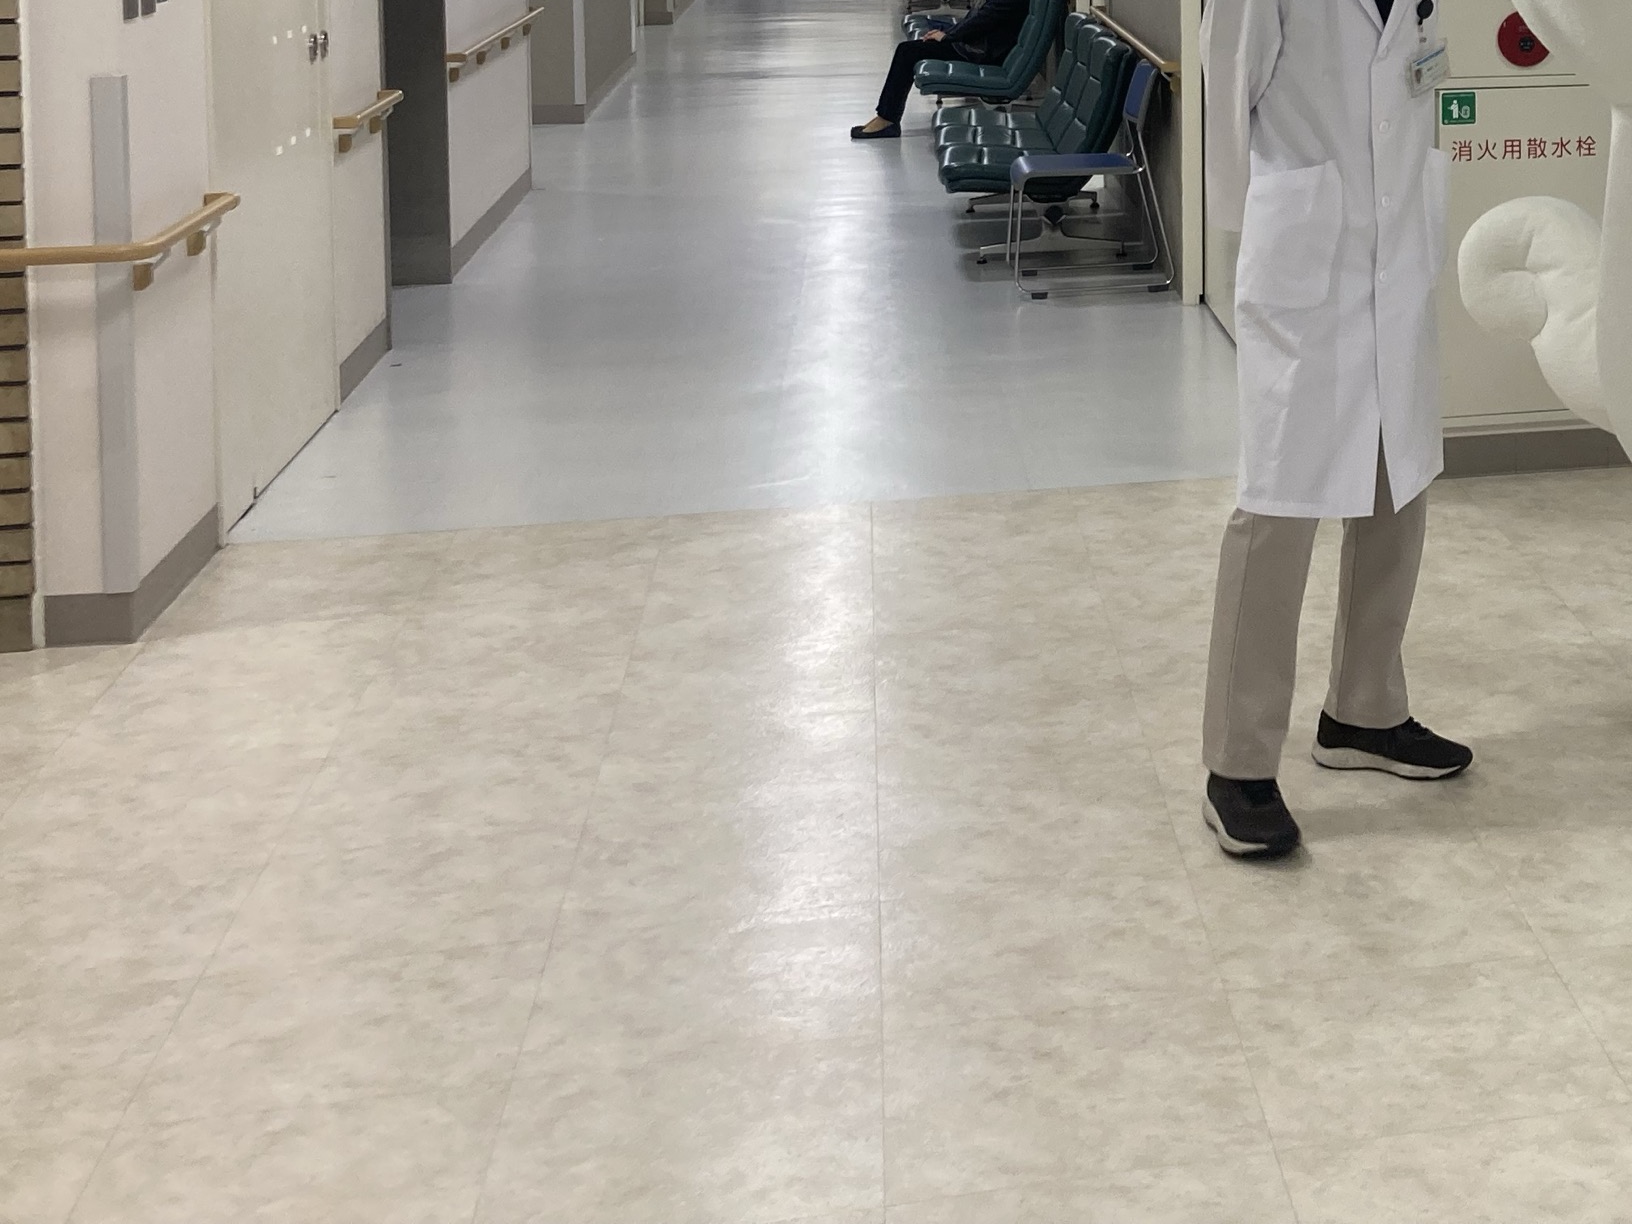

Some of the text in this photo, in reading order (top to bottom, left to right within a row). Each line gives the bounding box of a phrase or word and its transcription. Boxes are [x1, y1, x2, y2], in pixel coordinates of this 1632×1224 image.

[1451, 135, 1597, 162] 消火用散水栓
